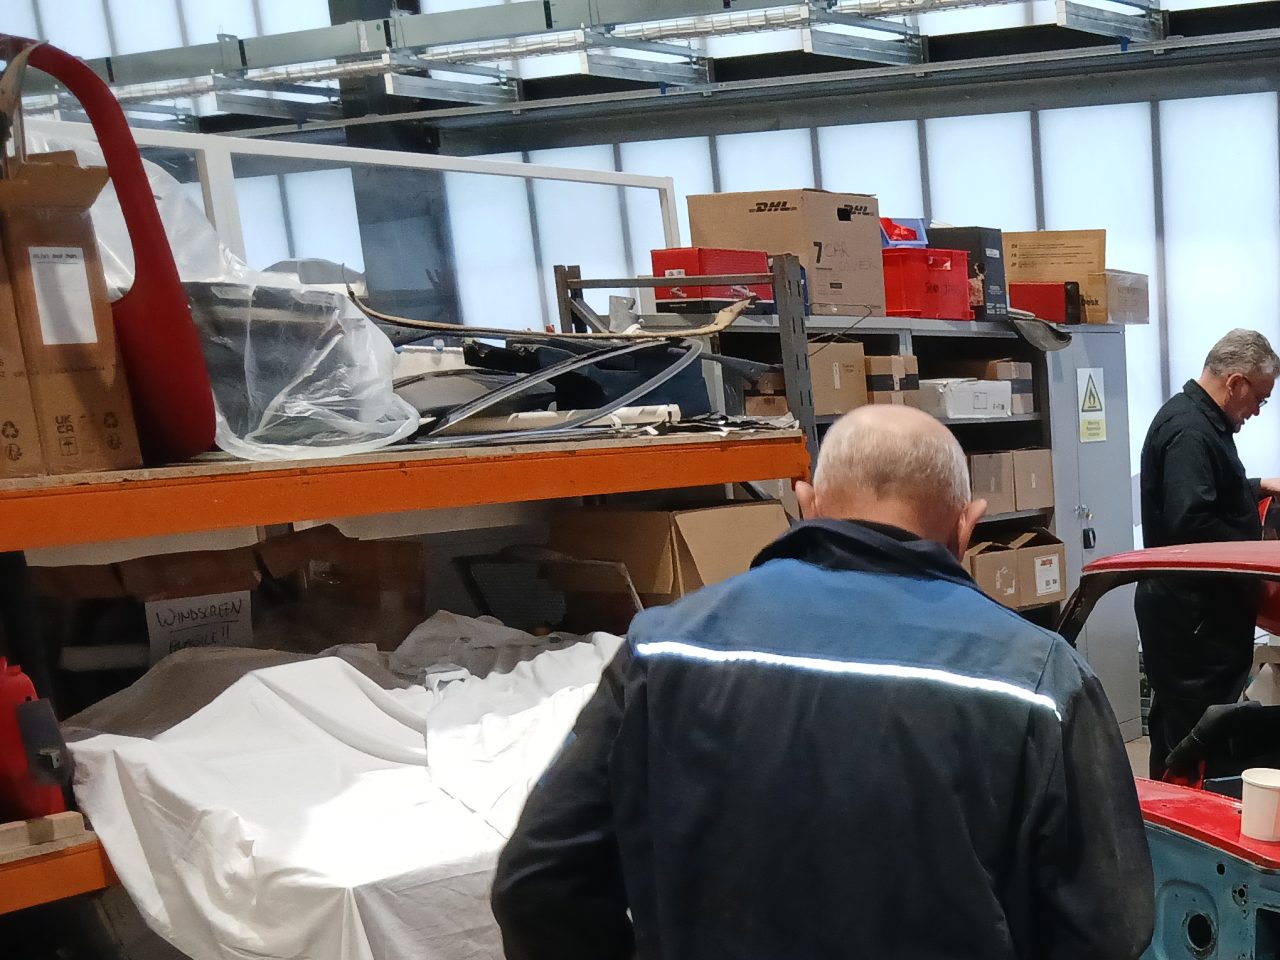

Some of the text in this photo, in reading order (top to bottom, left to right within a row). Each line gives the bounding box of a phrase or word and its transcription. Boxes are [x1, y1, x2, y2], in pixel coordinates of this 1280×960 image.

[753, 201, 794, 213] DHL
[813, 241, 823, 264] 7
[55, 414, 73, 424] UK
[56, 424, 75, 434] CA
[156, 598, 242, 628] WINDSCREEN
